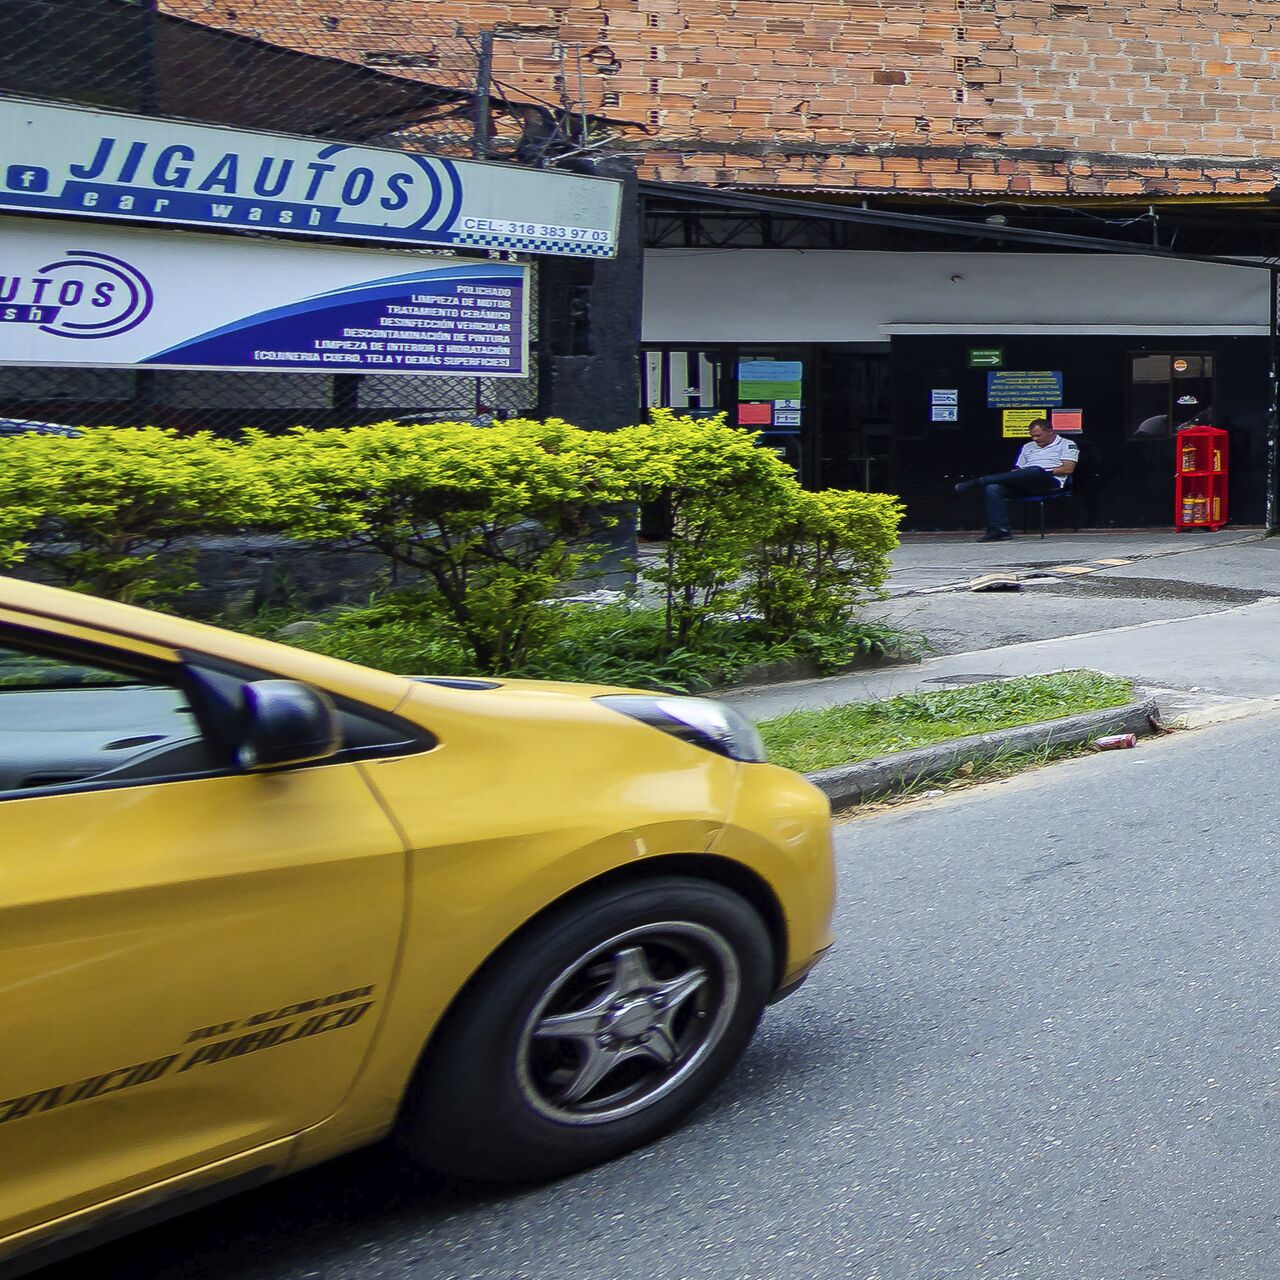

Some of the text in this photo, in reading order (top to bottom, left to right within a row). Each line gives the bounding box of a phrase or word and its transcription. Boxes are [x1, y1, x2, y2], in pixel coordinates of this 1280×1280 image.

[69, 137, 414, 210] JIGAUTOS
[83, 191, 320, 226] car wash
[464, 218, 609, 242] CEL: 318 383 97 03
[411, 294, 511, 308] LIMPIEZA DE MOTOR
[387, 305, 459, 318] TRATAMIENTO
[380, 317, 511, 332] DESINFECCIÓN VEHICULAR
[453, 333, 467, 341] DE
[468, 334, 511, 343] PINTURA
[315, 340, 368, 349] LIMPIEZA
[370, 342, 384, 351] DE
[387, 343, 436, 352] INTERIOR
[365, 355, 393, 363] TELA
[405, 355, 441, 365] DEMÁS
